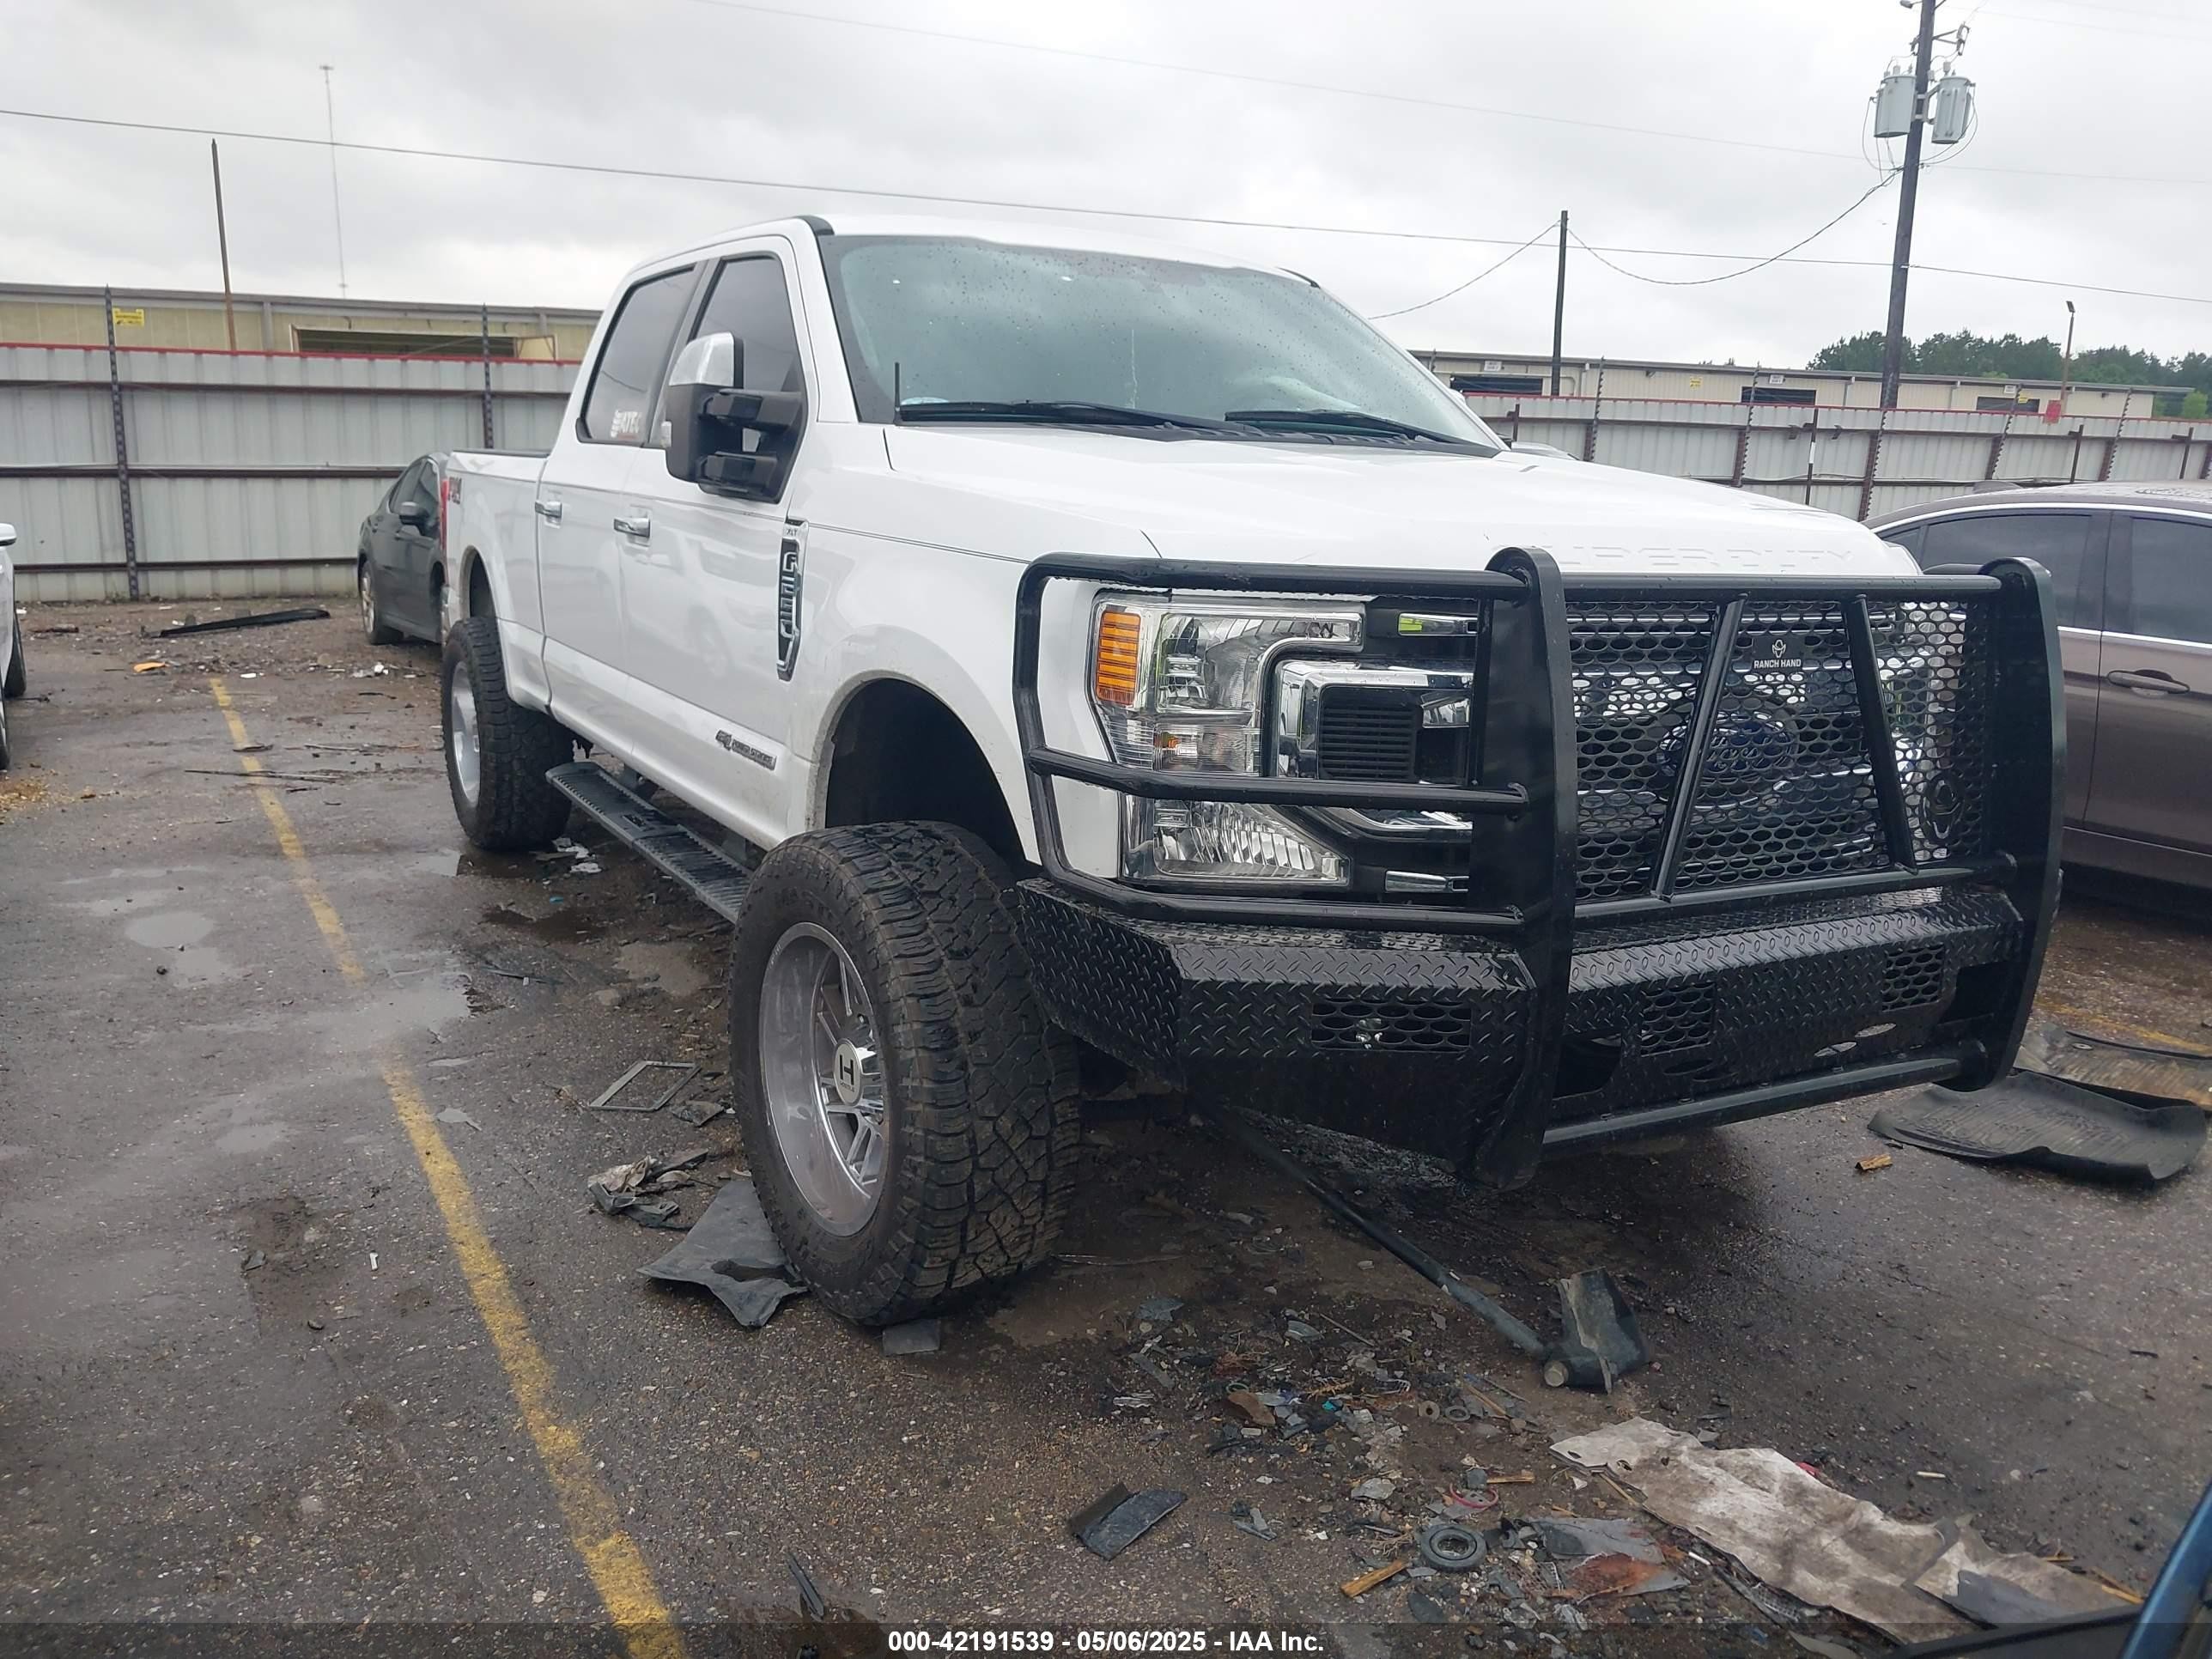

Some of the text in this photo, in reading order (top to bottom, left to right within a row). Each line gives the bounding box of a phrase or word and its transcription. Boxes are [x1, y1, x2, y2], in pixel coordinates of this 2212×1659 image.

[1499, 544, 1720, 567] UPER
[1753, 659, 1802, 669] RANCH HAND
